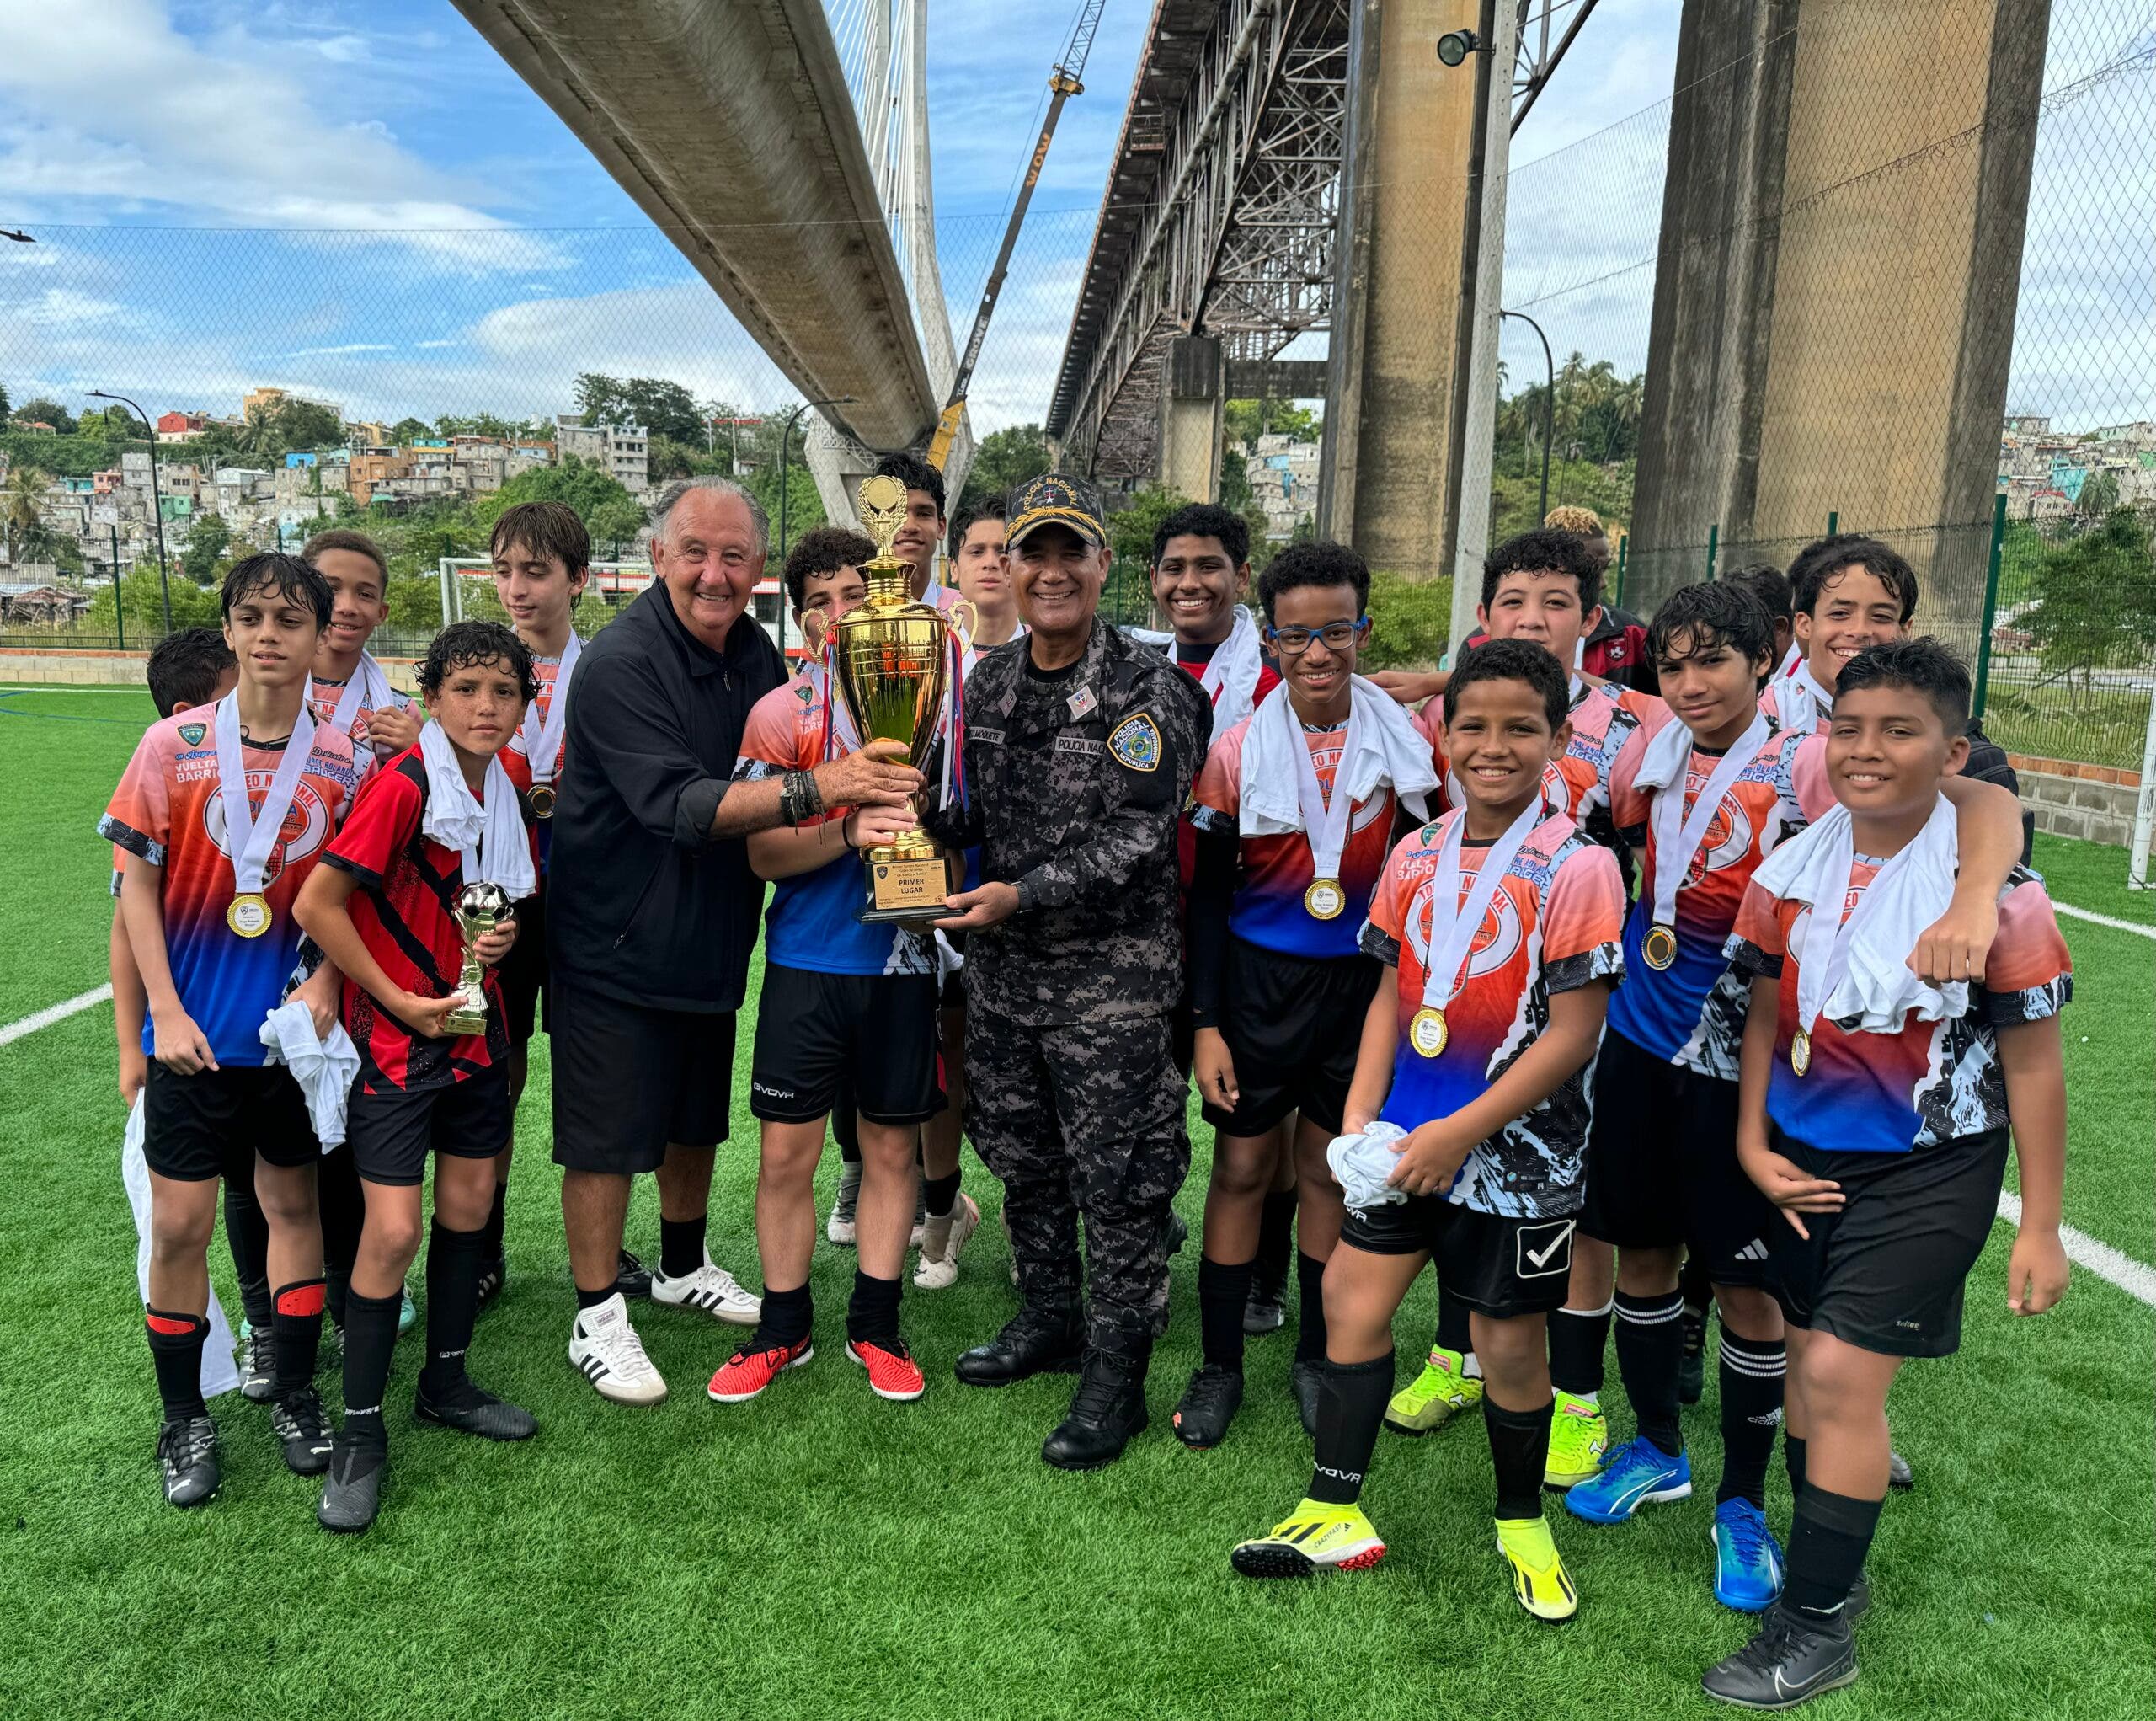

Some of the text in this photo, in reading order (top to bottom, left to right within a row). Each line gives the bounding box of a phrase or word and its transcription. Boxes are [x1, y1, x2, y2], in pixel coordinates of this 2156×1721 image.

[1023, 477, 1079, 511] POLICIA NACIONAL
[1114, 719, 1141, 741] POLICIA
[1115, 723, 1150, 751] NACIONAL
[1059, 740, 1085, 751] POLICIA
[175, 759, 218, 772] VUELTA
[899, 878, 924, 886] PRIMER
